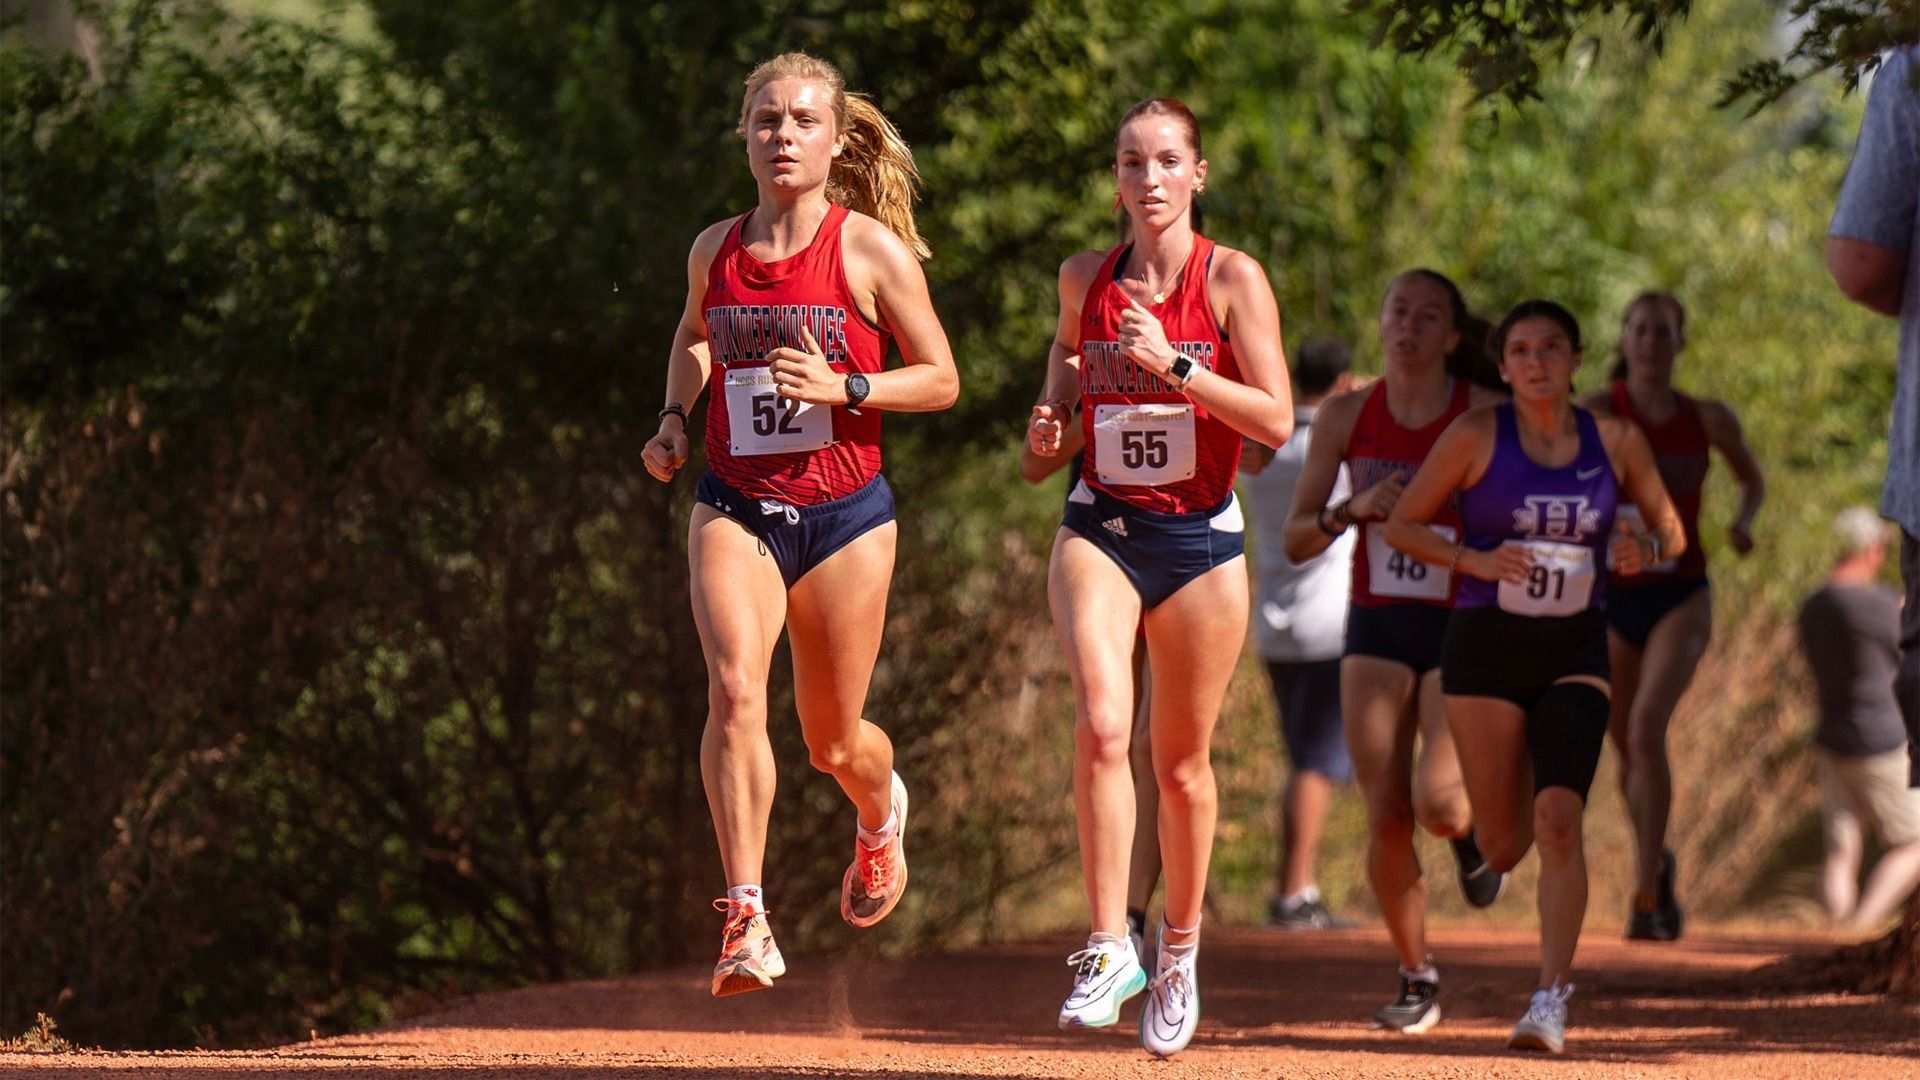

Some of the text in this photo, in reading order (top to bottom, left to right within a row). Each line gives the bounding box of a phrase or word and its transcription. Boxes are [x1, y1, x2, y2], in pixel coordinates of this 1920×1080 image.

[752, 393, 803, 437] 52
[1121, 430, 1168, 469] 55
[1527, 565, 1565, 602] 91
